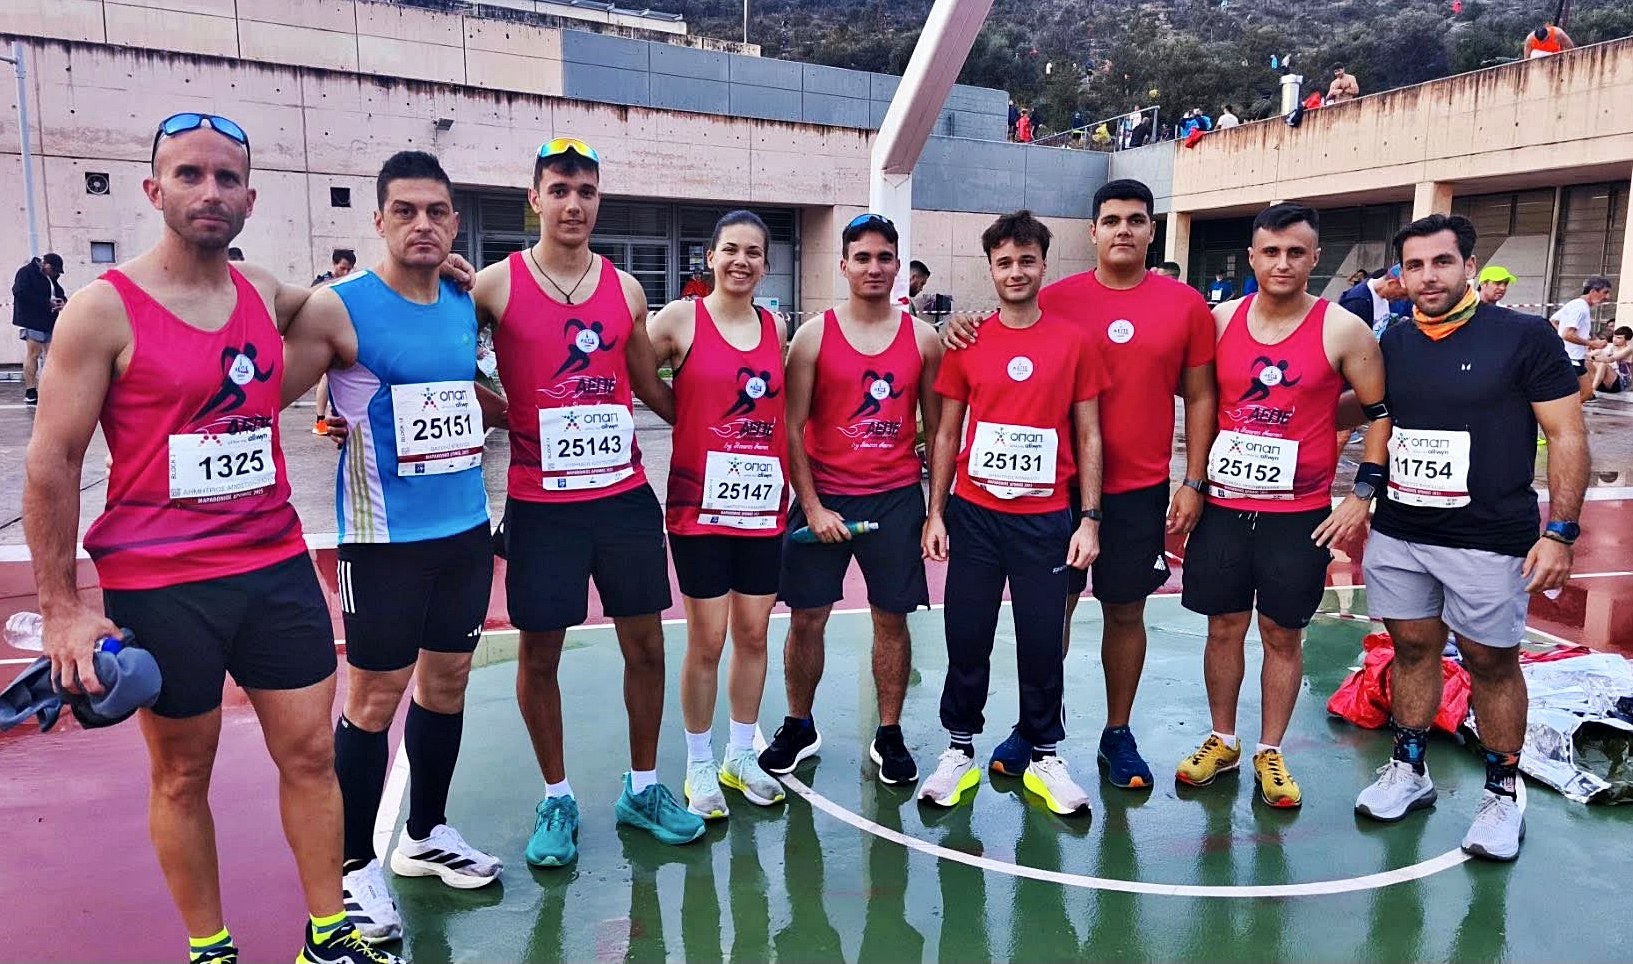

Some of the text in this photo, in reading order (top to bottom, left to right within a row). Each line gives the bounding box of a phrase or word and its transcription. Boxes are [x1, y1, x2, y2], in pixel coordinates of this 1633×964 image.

[247, 433, 268, 442] allwyn
[412, 414, 472, 441] 25151
[557, 435, 621, 458] 25143
[199, 449, 264, 480] 1325
[983, 451, 1042, 472] 25131
[1218, 457, 1281, 483] 25152
[1395, 456, 1453, 479] 11754
[717, 482, 773, 501] 25147
